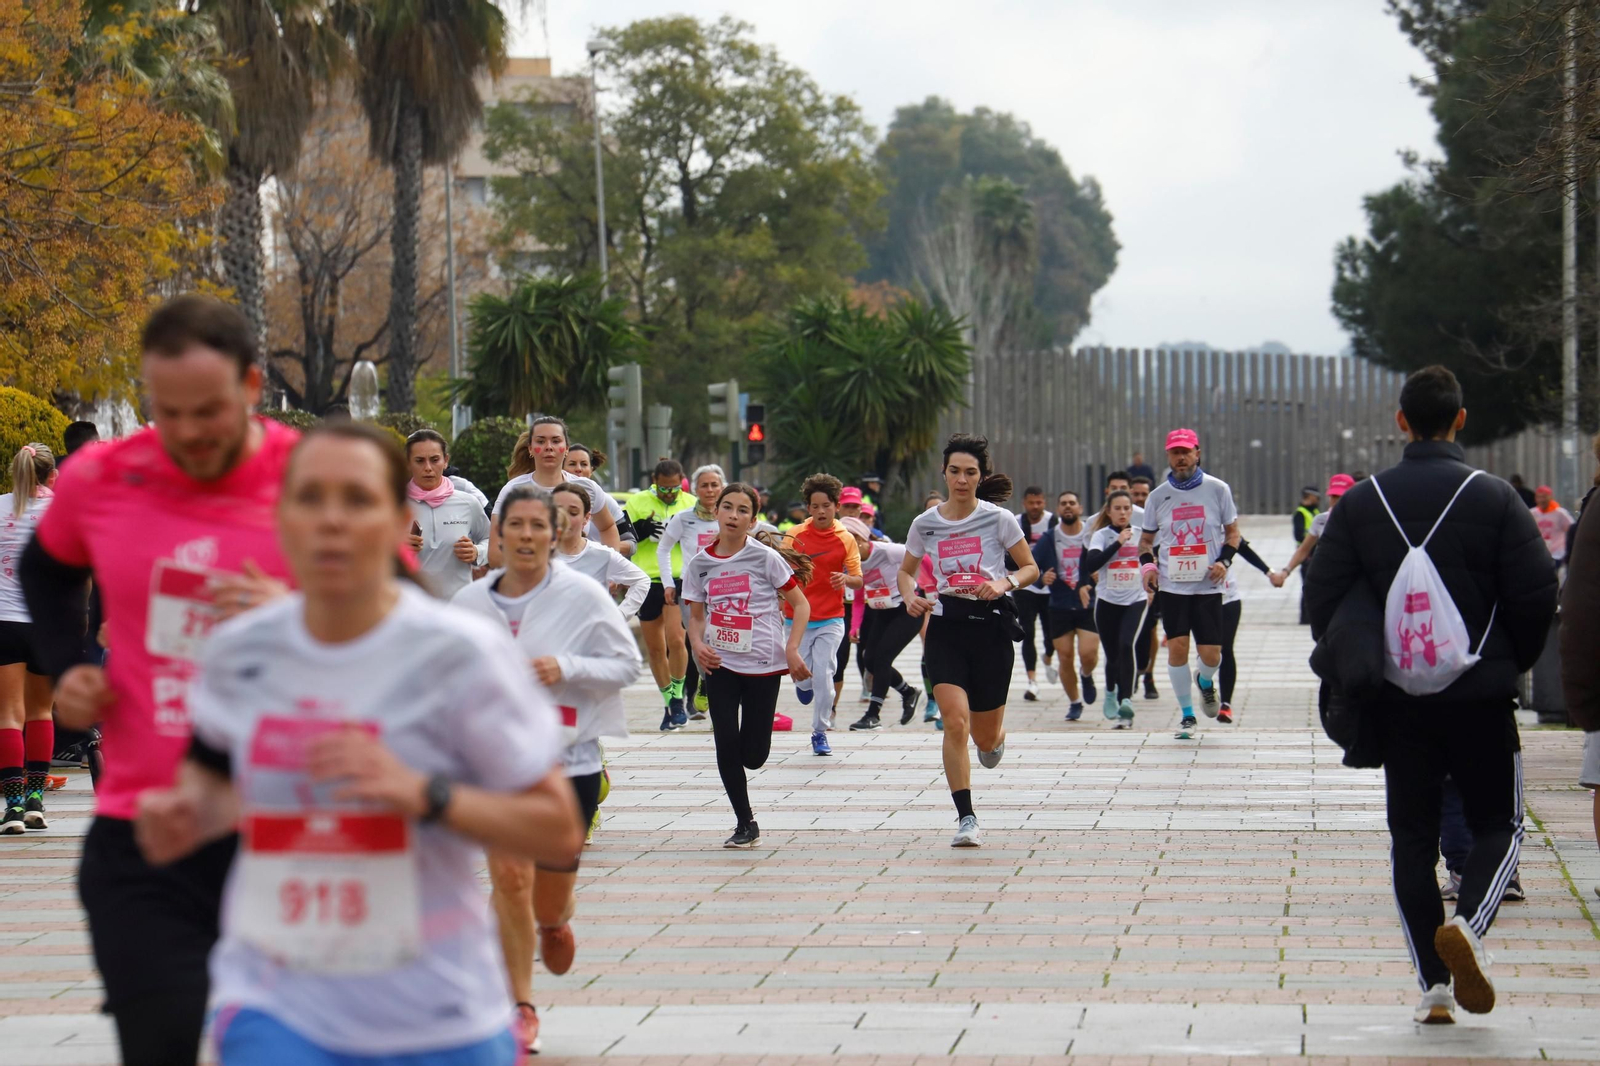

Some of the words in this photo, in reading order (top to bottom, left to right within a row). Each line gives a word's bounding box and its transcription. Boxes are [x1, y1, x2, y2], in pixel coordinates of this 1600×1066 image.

[1177, 560, 1197, 571] 711
[1113, 573, 1135, 581] 1587
[716, 629, 740, 644] 2553
[279, 877, 368, 926] 918
